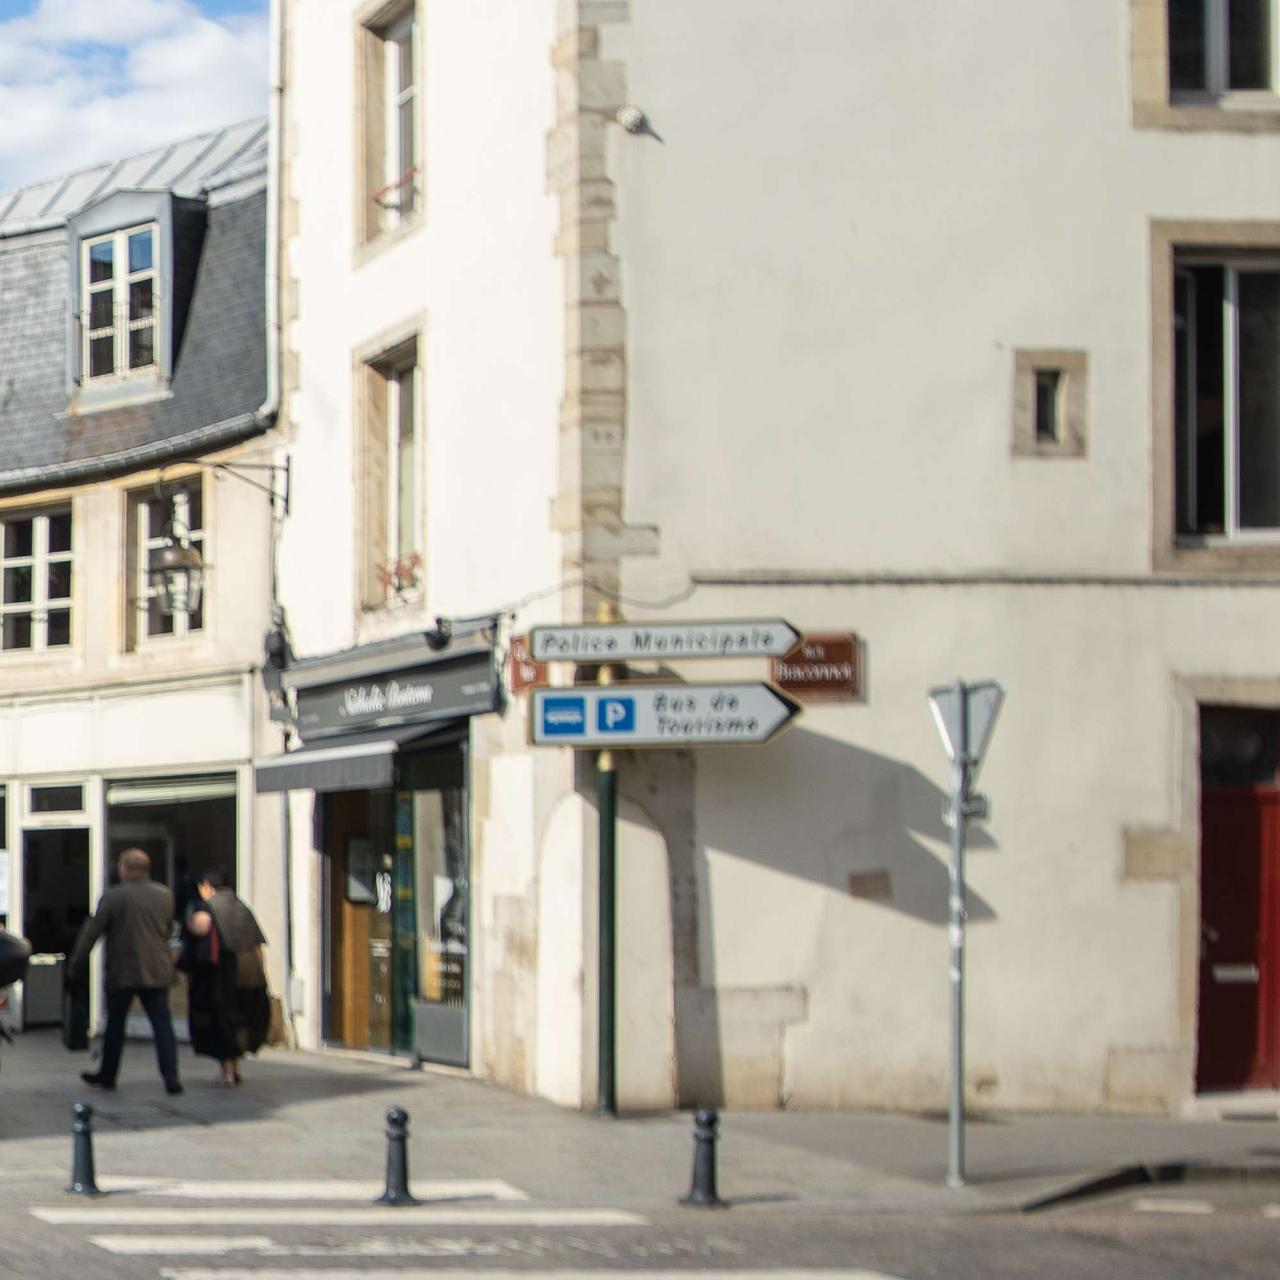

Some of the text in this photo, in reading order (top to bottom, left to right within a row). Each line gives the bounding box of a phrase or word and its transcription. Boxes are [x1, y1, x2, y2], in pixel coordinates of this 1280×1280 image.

[543, 632, 618, 653] Police
[633, 627, 775, 656] Municipale
[653, 690, 740, 712] Bus de
[656, 714, 760, 736] Tourisme
